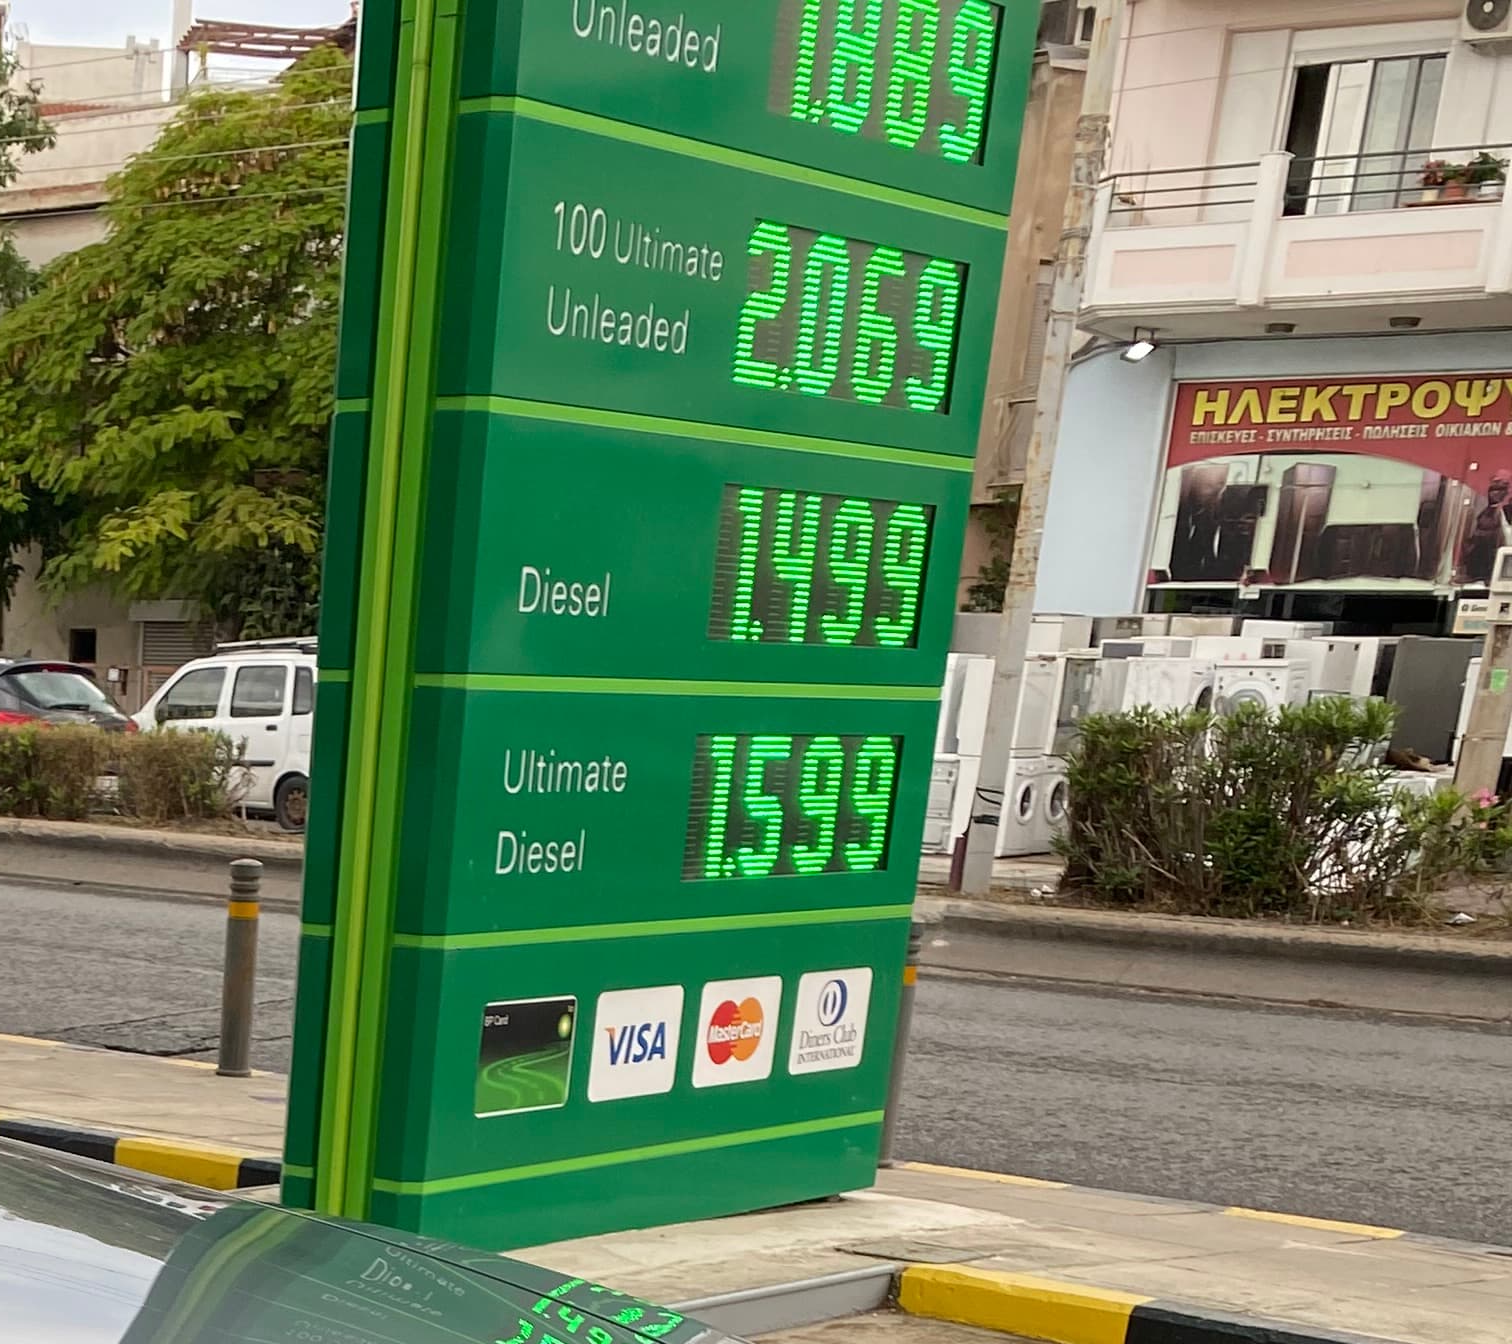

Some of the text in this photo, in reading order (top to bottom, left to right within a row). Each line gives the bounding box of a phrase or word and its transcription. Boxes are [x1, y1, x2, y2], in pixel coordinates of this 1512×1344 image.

[573, 0, 720, 73] Unleaded
[554, 201, 723, 282] 100 Ultimate
[548, 287, 689, 354] Unleaded
[1191, 379, 1512, 425] ΗΛΕΚΤΡΟΨ
[518, 566, 610, 617] Diesel
[504, 750, 627, 794] Ultimate
[495, 830, 585, 874] Diesel
[605, 1021, 666, 1065] VISA
[707, 1020, 761, 1044] MasterCard
[799, 1023, 857, 1049] Diners Club
